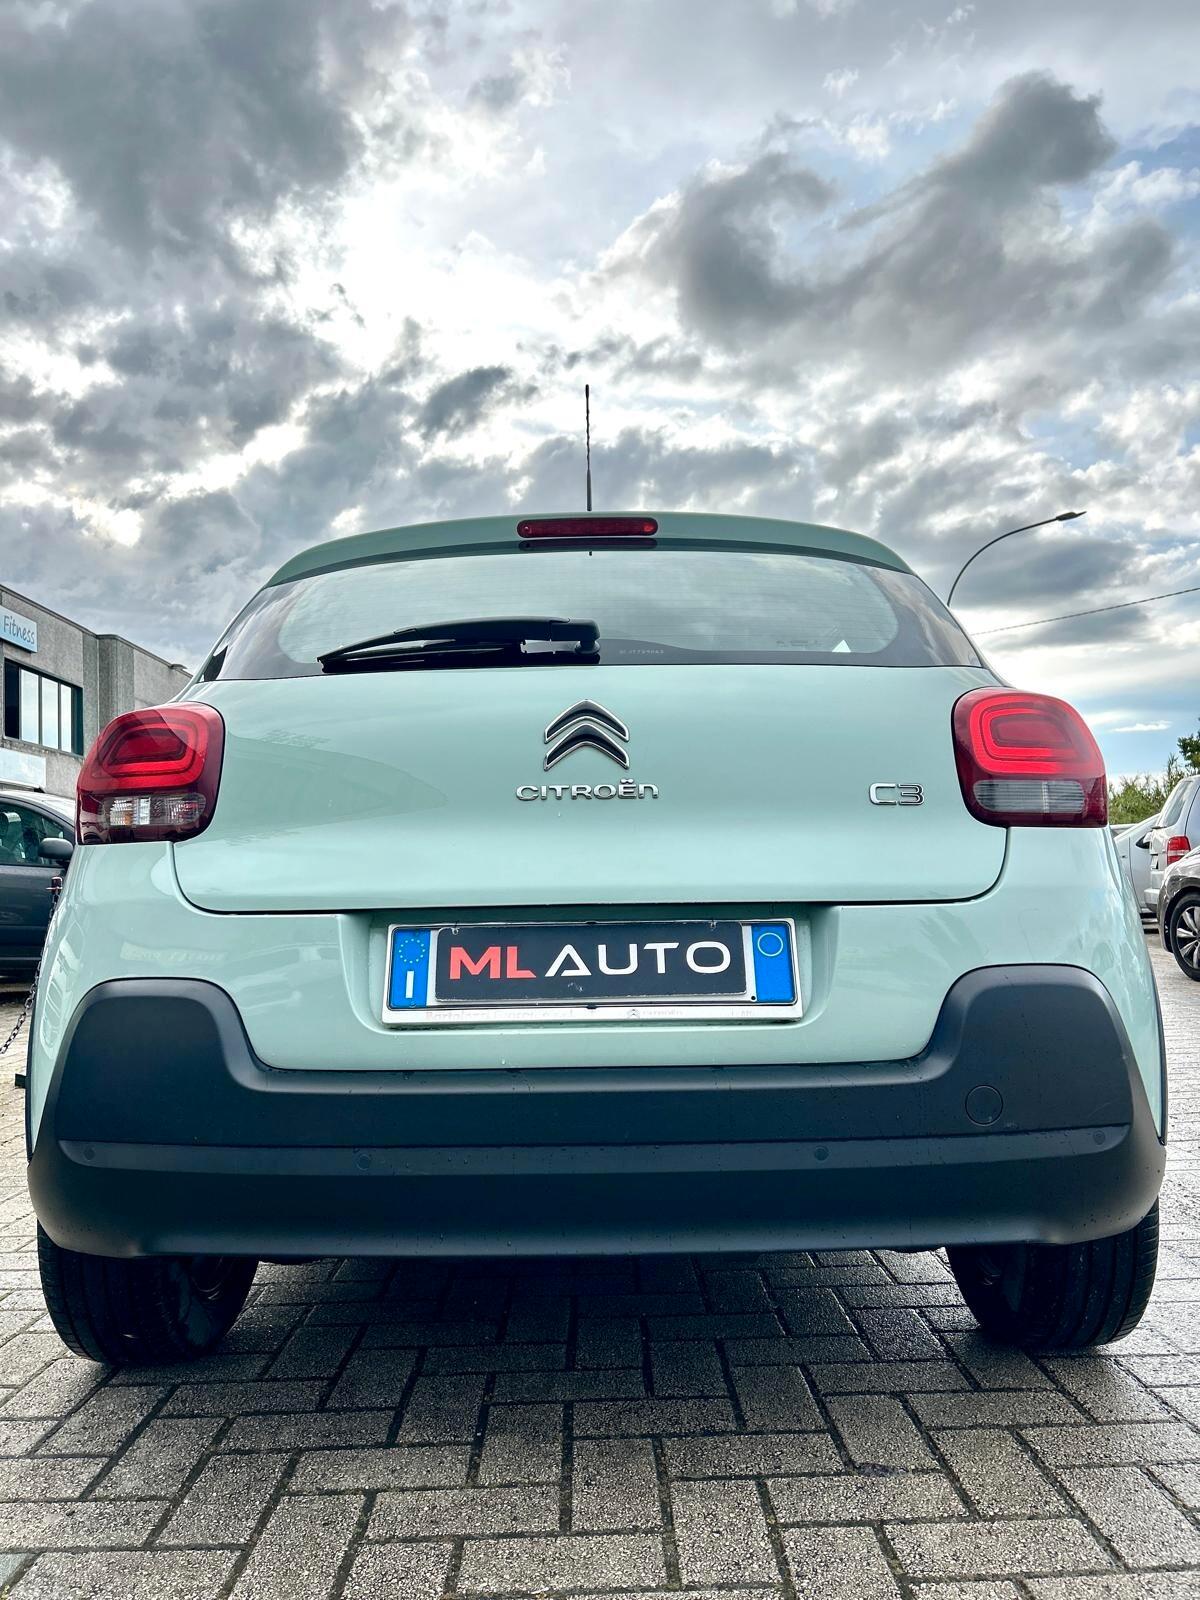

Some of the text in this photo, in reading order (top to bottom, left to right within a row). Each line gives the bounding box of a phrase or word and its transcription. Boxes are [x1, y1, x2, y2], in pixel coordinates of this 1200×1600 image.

[4, 615, 35, 645] Fitness
[869, 783, 924, 805] C3
[449, 941, 731, 980] ML AUTO
